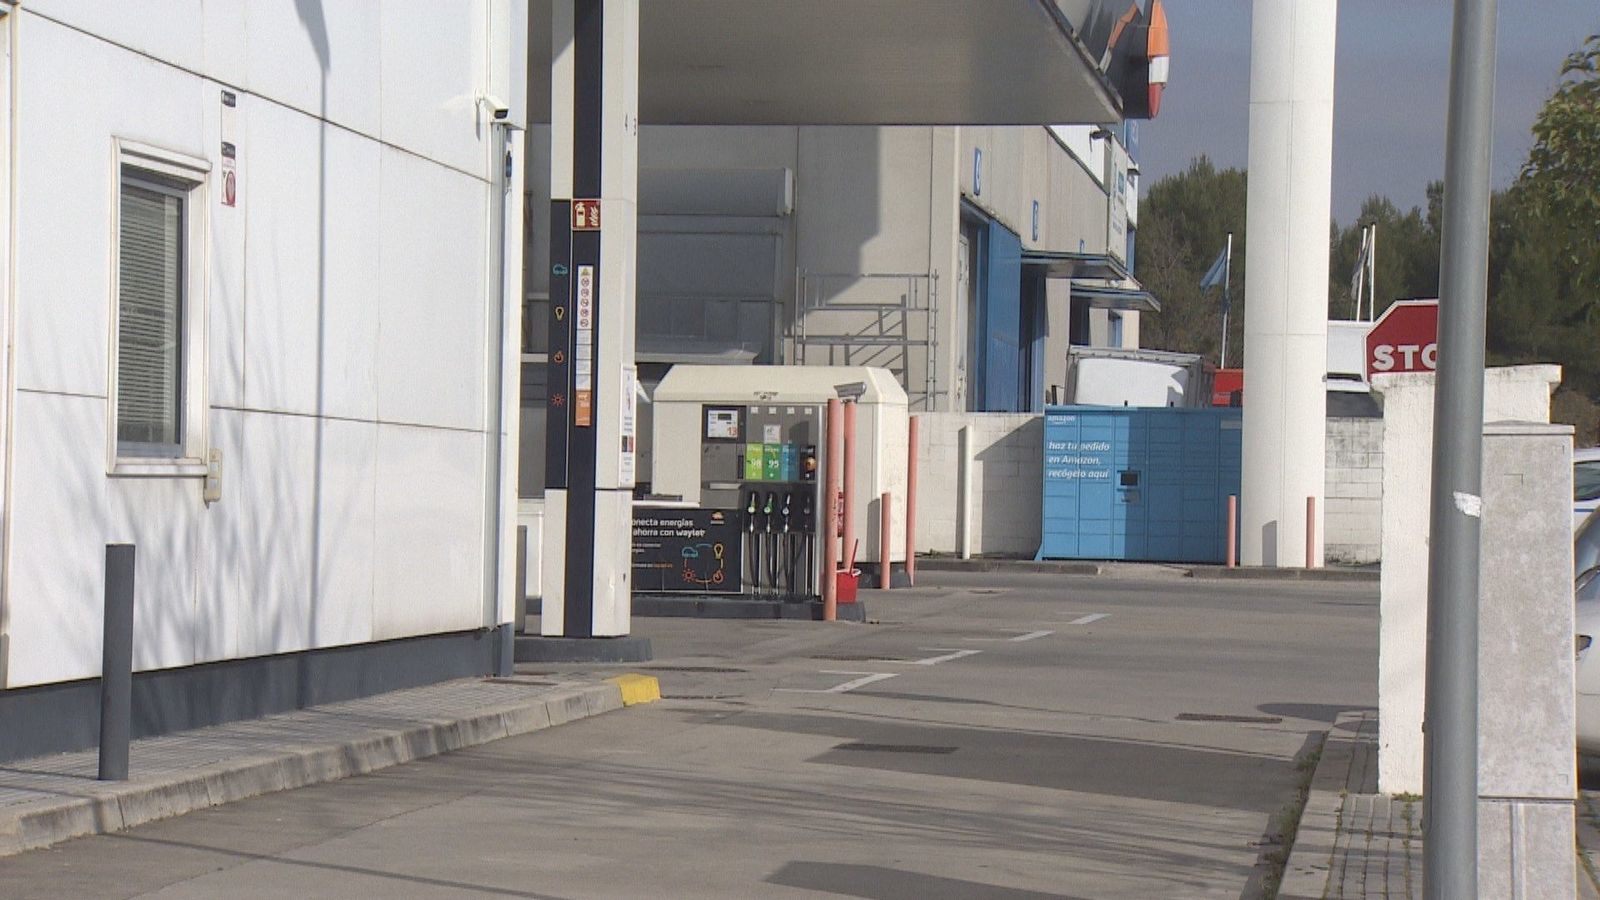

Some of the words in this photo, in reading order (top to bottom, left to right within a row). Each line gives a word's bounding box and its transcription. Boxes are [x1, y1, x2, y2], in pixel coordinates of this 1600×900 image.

[1372, 343, 1437, 371] STO
[1048, 441, 1066, 450] haz
[1080, 441, 1110, 453] pedido
[768, 459, 779, 469] 95
[1048, 456, 1060, 464] en
[632, 518, 658, 527] onecta
[632, 528, 658, 537] ahorra
[660, 529, 674, 537] con
